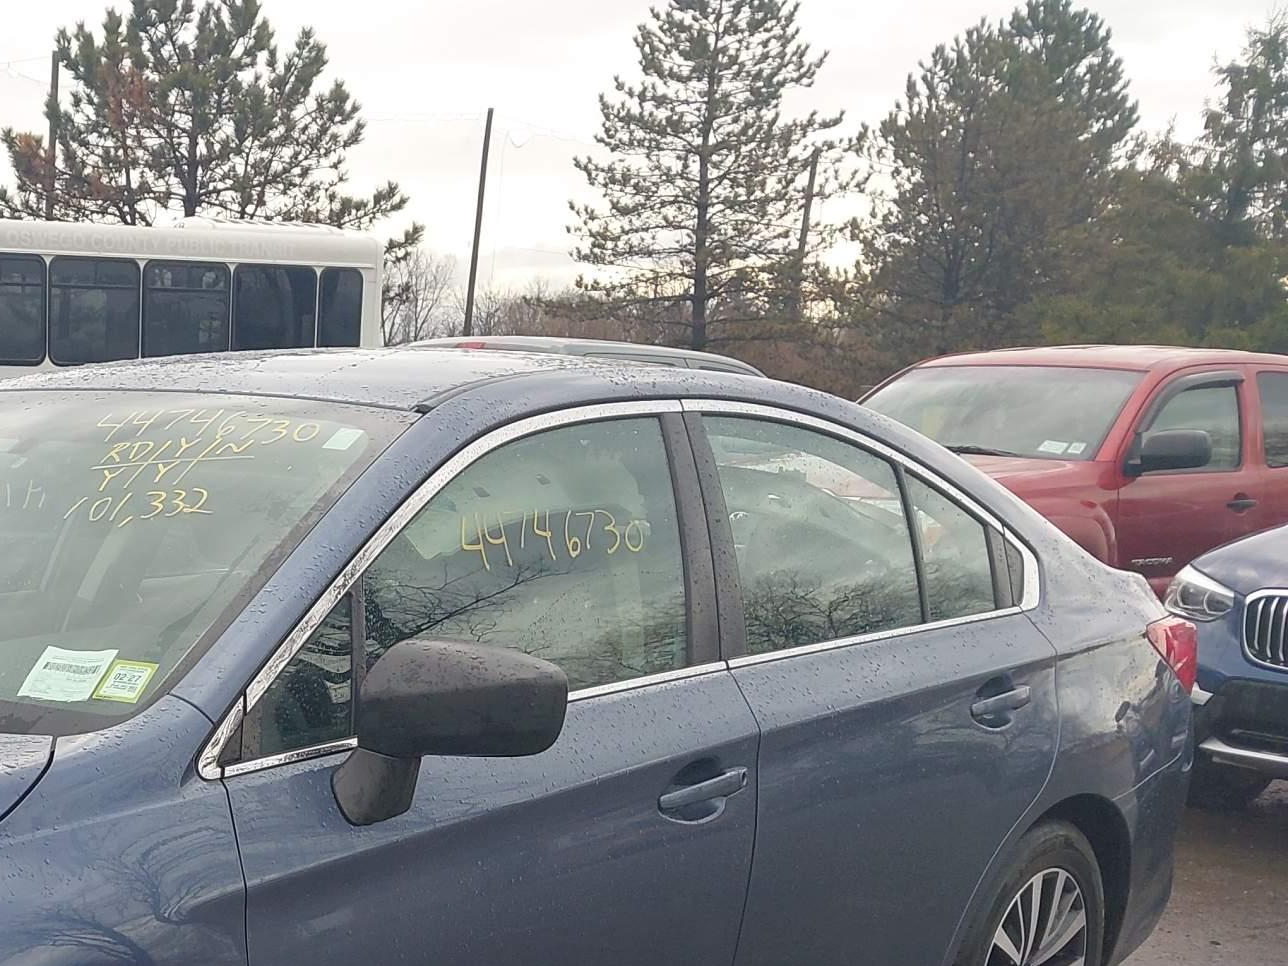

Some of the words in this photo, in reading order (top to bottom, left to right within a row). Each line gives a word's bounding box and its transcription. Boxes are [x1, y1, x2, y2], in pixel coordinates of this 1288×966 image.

[6, 230, 86, 248] OSWEGO
[91, 233, 163, 251] COUNTY
[167, 237, 226, 255] PUBLIC
[230, 239, 297, 257] TRANSIT
